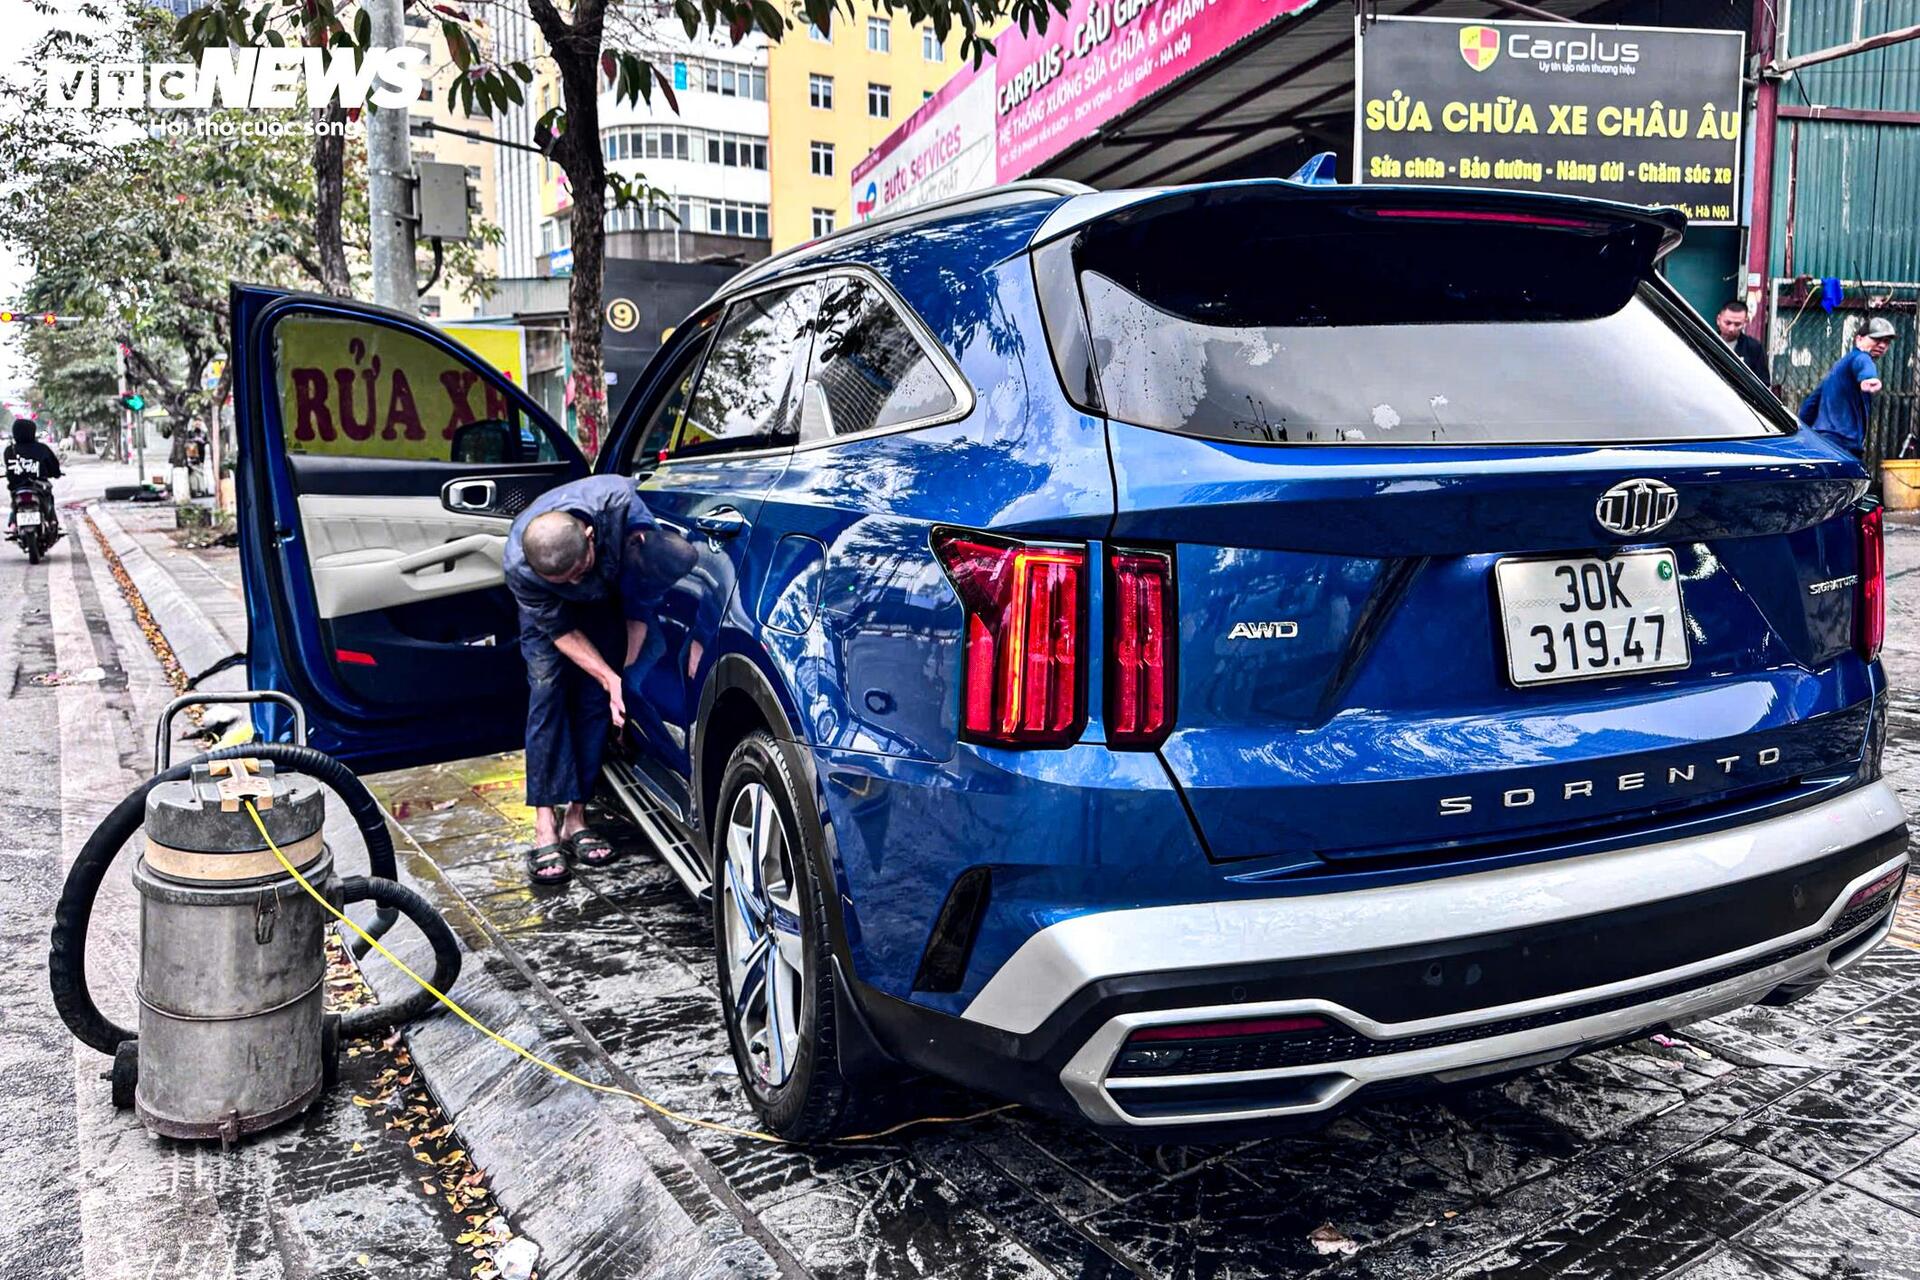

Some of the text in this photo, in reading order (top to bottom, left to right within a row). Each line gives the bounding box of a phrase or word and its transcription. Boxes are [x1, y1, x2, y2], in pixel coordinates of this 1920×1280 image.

[997, 43, 1063, 115] CARPLUS
[1074, 1, 1111, 58] CẦU
[1508, 33, 1640, 64] Carplus
[1366, 89, 1739, 140] SỬA CHỮA XE CHÂU ÂU
[884, 165, 907, 204] auto
[910, 124, 961, 184] services
[1370, 154, 1401, 178] Sửa
[1405, 157, 1445, 179] chữa
[1460, 155, 1491, 179] Bảo
[1556, 160, 1596, 183] Nâng
[1638, 162, 1681, 183] Chăm
[1684, 164, 1711, 184] sóc
[1714, 167, 1732, 184] xe
[1695, 205, 1710, 218] Hà
[1712, 205, 1729, 220] Nội
[612, 303, 633, 327] 9
[291, 337, 427, 441] RỬA
[1555, 562, 1632, 613] 30K
[1228, 621, 1298, 640] AWD
[1530, 614, 1665, 674] 319.47
[1439, 747, 1780, 816] SORENTO
